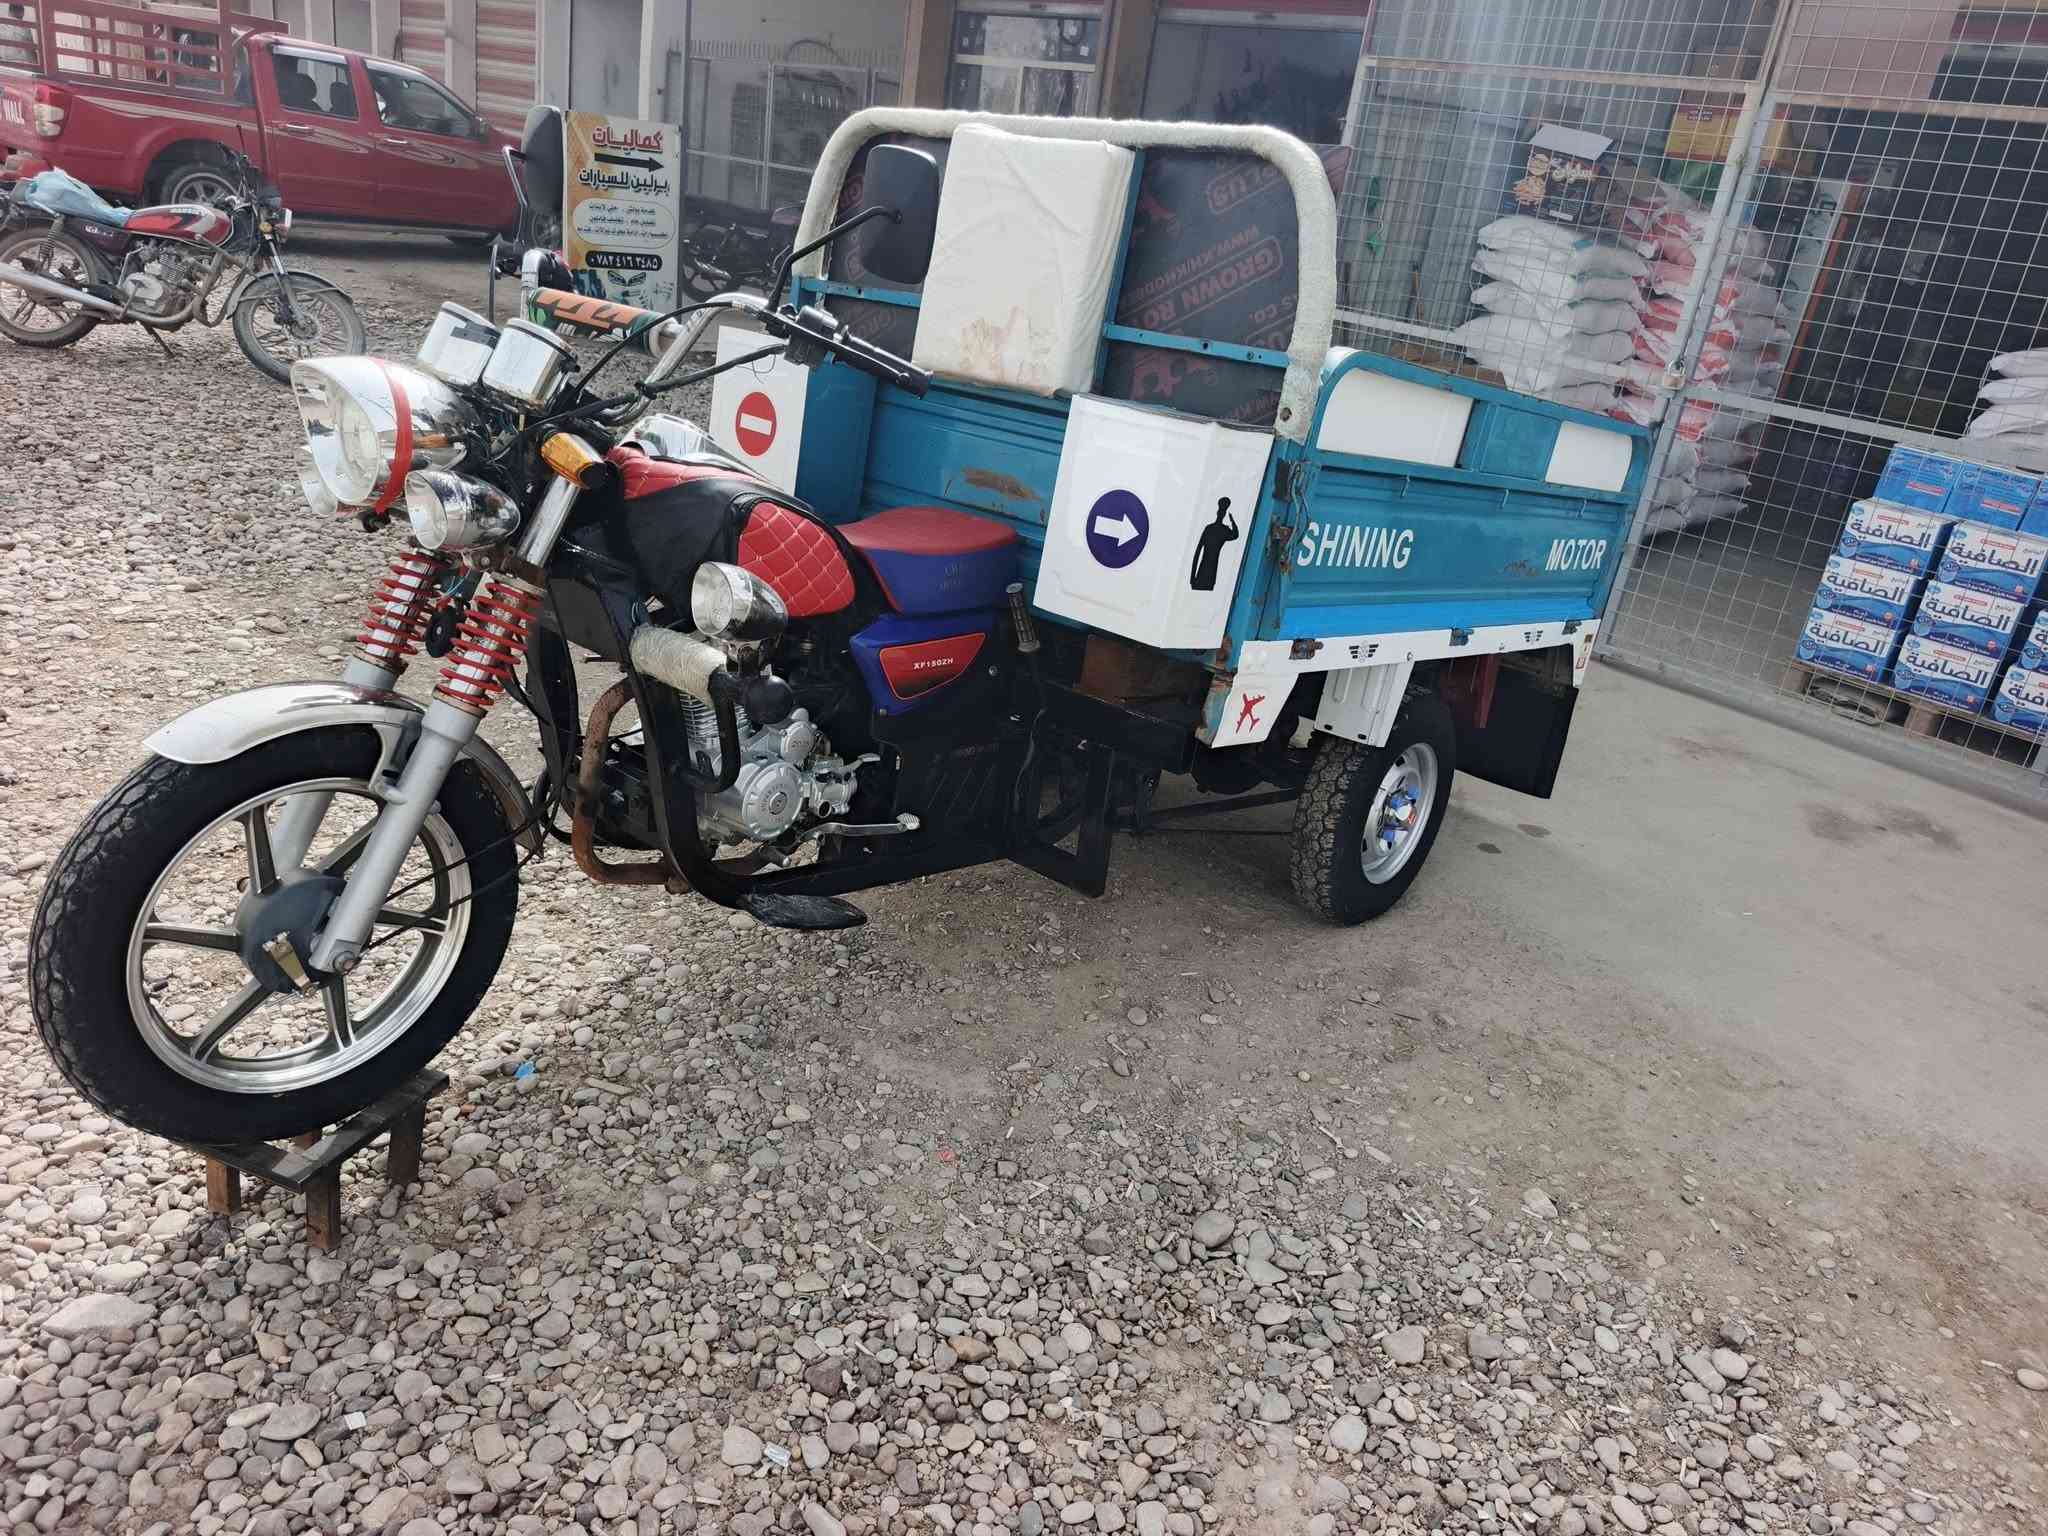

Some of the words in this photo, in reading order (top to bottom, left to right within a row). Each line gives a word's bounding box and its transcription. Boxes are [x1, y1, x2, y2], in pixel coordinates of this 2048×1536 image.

[592, 126, 664, 154] كماليات
[579, 169, 628, 188] للسيارات
[1297, 522, 1414, 569] SHINING
[1545, 539, 1607, 571] MOTOR
[1851, 519, 1931, 549] الصافية
[1950, 543, 2039, 575] الصافية
[1827, 571, 1904, 602] الصافية
[1925, 598, 2011, 631] الصافية
[1809, 623, 1886, 655] الصافية
[1906, 652, 1989, 686] الصافية
